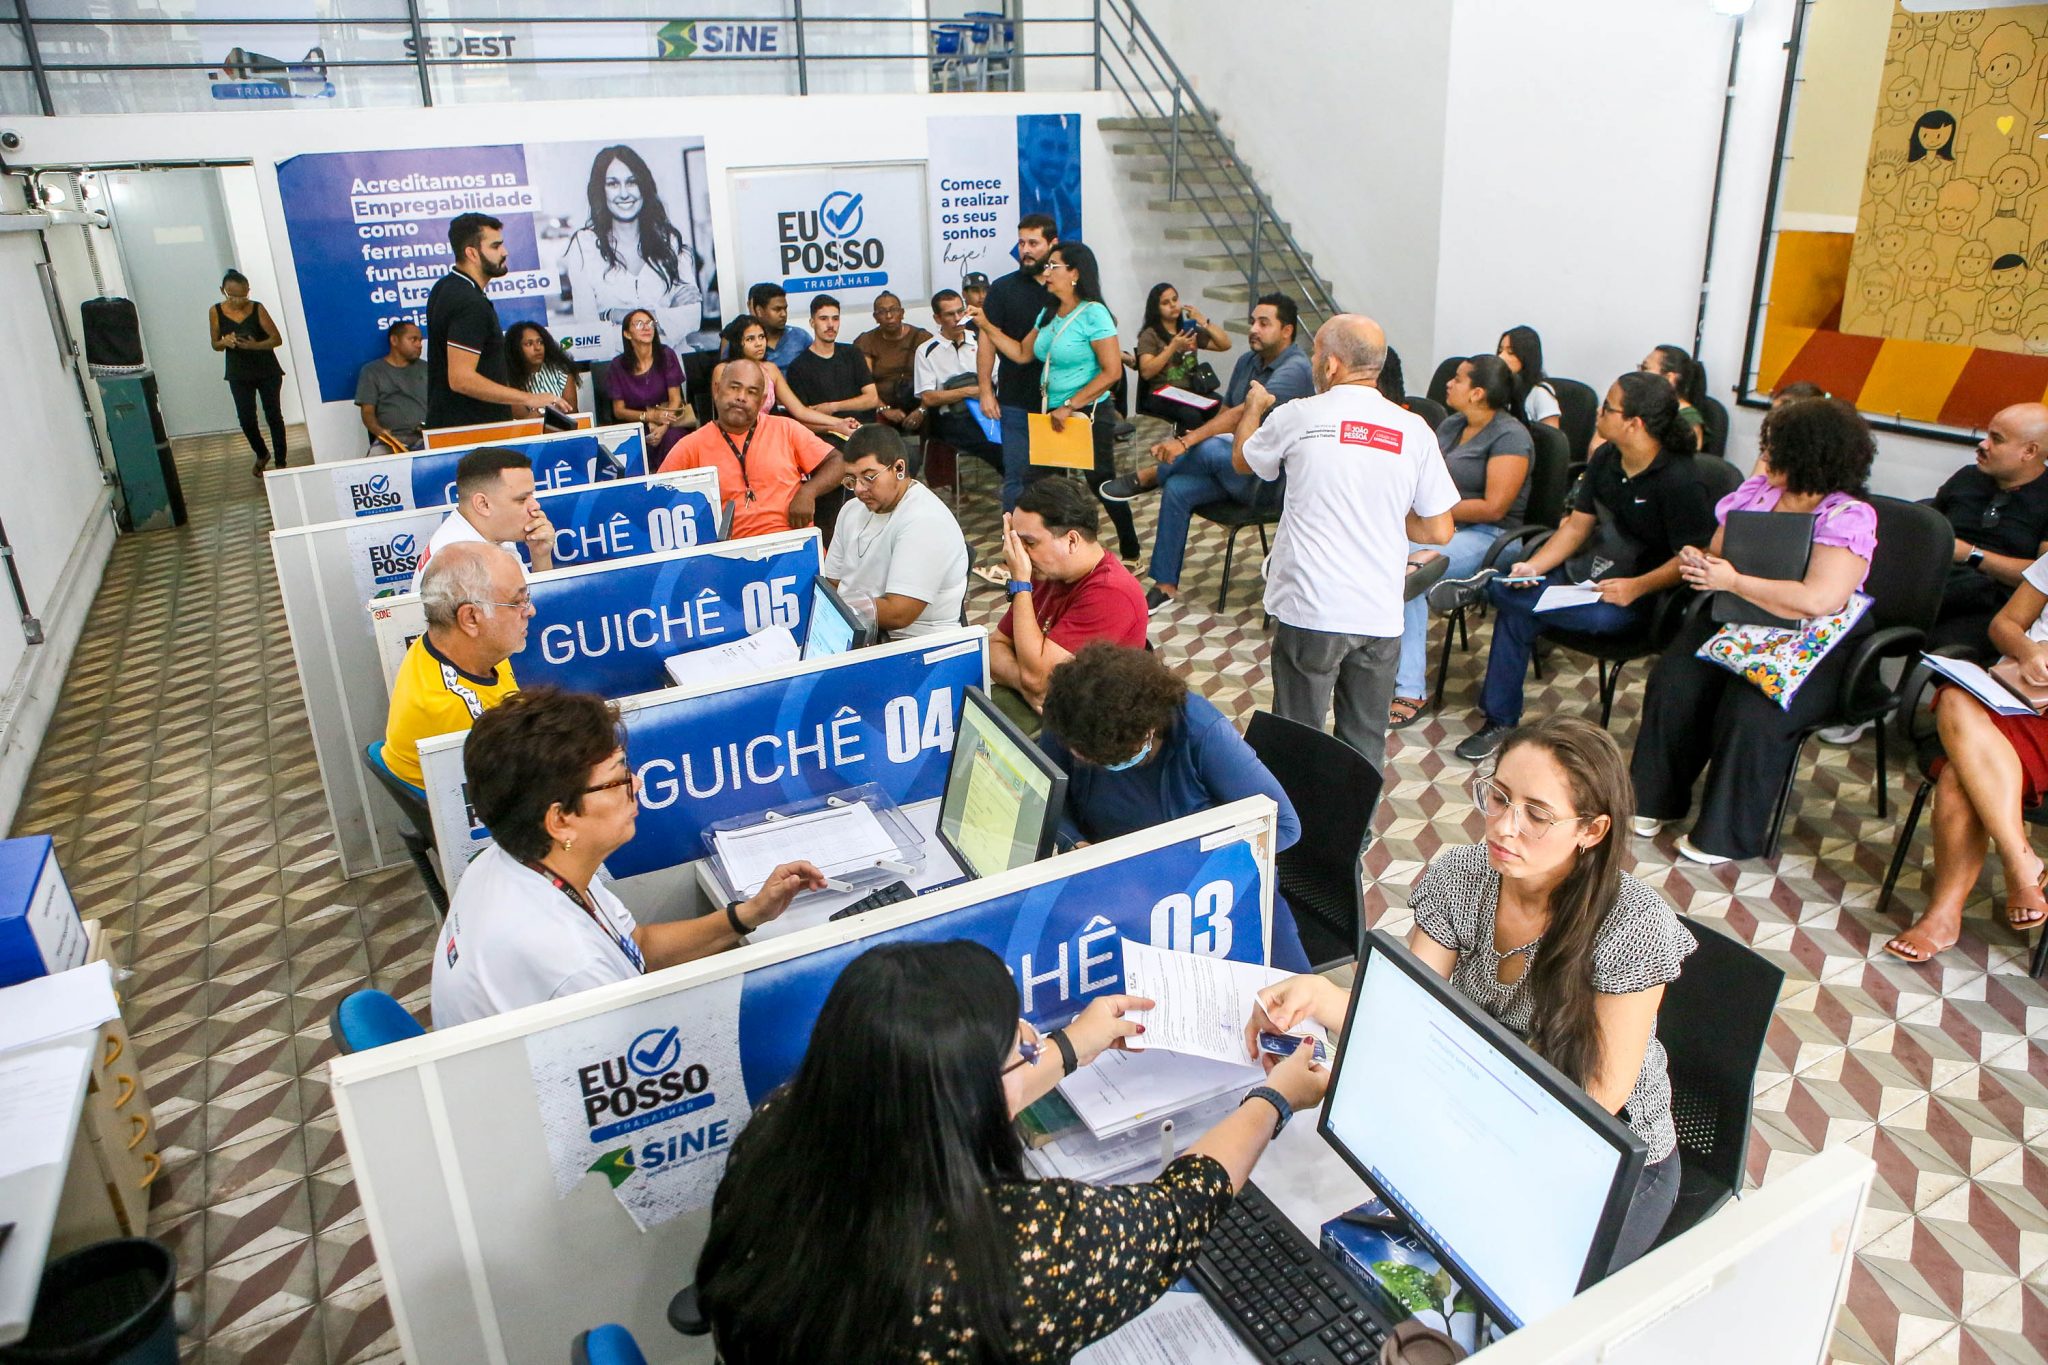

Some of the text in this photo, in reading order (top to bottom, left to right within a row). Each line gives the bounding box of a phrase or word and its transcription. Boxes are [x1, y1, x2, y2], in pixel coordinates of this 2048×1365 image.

[235, 87, 289, 96] TRABAL
[351, 173, 517, 194] Acreditamos na
[941, 179, 1002, 191] Comece
[354, 191, 532, 217] Empregabilidade
[942, 192, 1009, 207] a realizar
[778, 210, 819, 243] EU
[942, 212, 997, 224] os seus
[358, 222, 419, 239] como
[943, 226, 996, 240] sonhos
[780, 238, 885, 275] POSSO
[804, 276, 870, 289] TRABALHAR
[370, 287, 397, 303] de
[350, 483, 369, 498] EU
[353, 492, 401, 510] POSSO
[647, 504, 698, 552] 06
[369, 544, 392, 562] EU
[541, 588, 724, 665] GUICHÊ
[742, 575, 800, 635] 05
[636, 687, 954, 810] GUICHÊ 04
[1150, 879, 1234, 960] 03
[578, 1056, 629, 1097] EU
[584, 1064, 709, 1127] POSSO
